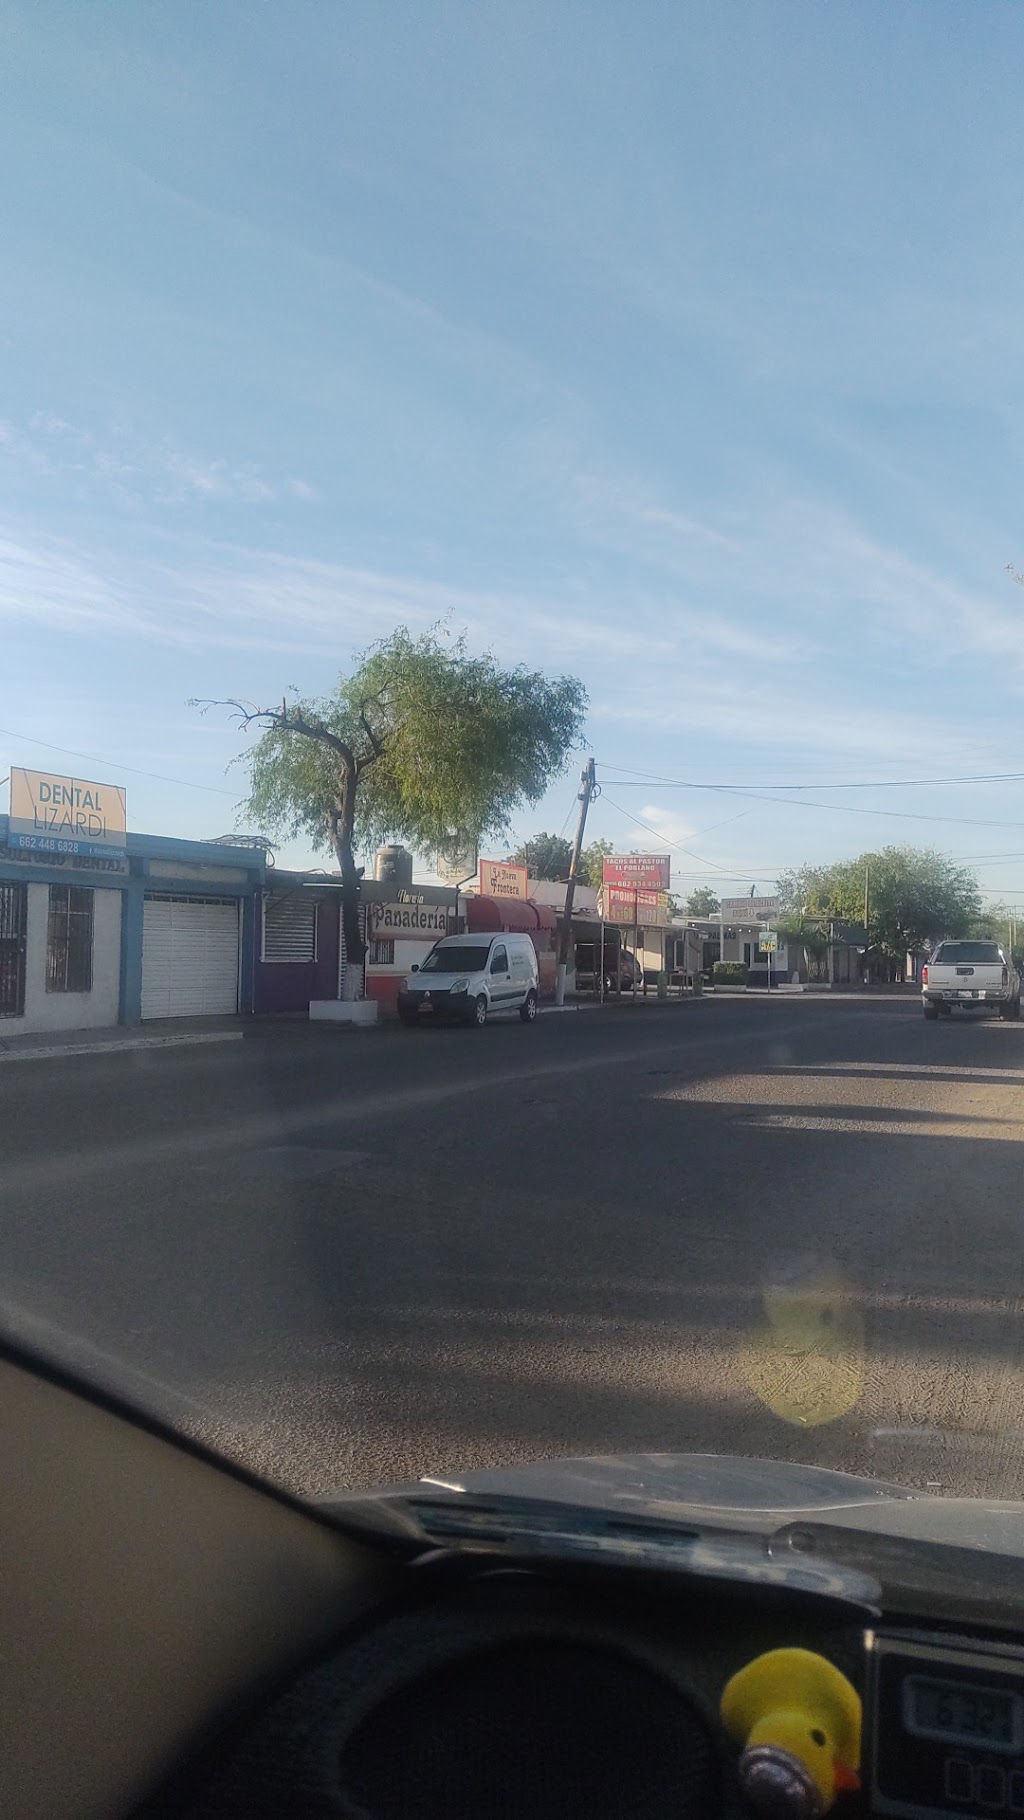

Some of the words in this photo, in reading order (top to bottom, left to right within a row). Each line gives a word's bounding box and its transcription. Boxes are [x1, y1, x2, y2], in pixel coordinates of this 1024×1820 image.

[39, 782, 102, 811] DENTAL
[33, 805, 107, 838] LIZARDI
[19, 836, 36, 849] 662
[38, 839, 55, 851] 448
[490, 878, 520, 896] Frontera
[371, 903, 446, 930] Panadería
[761, 940, 776, 951] A/C
